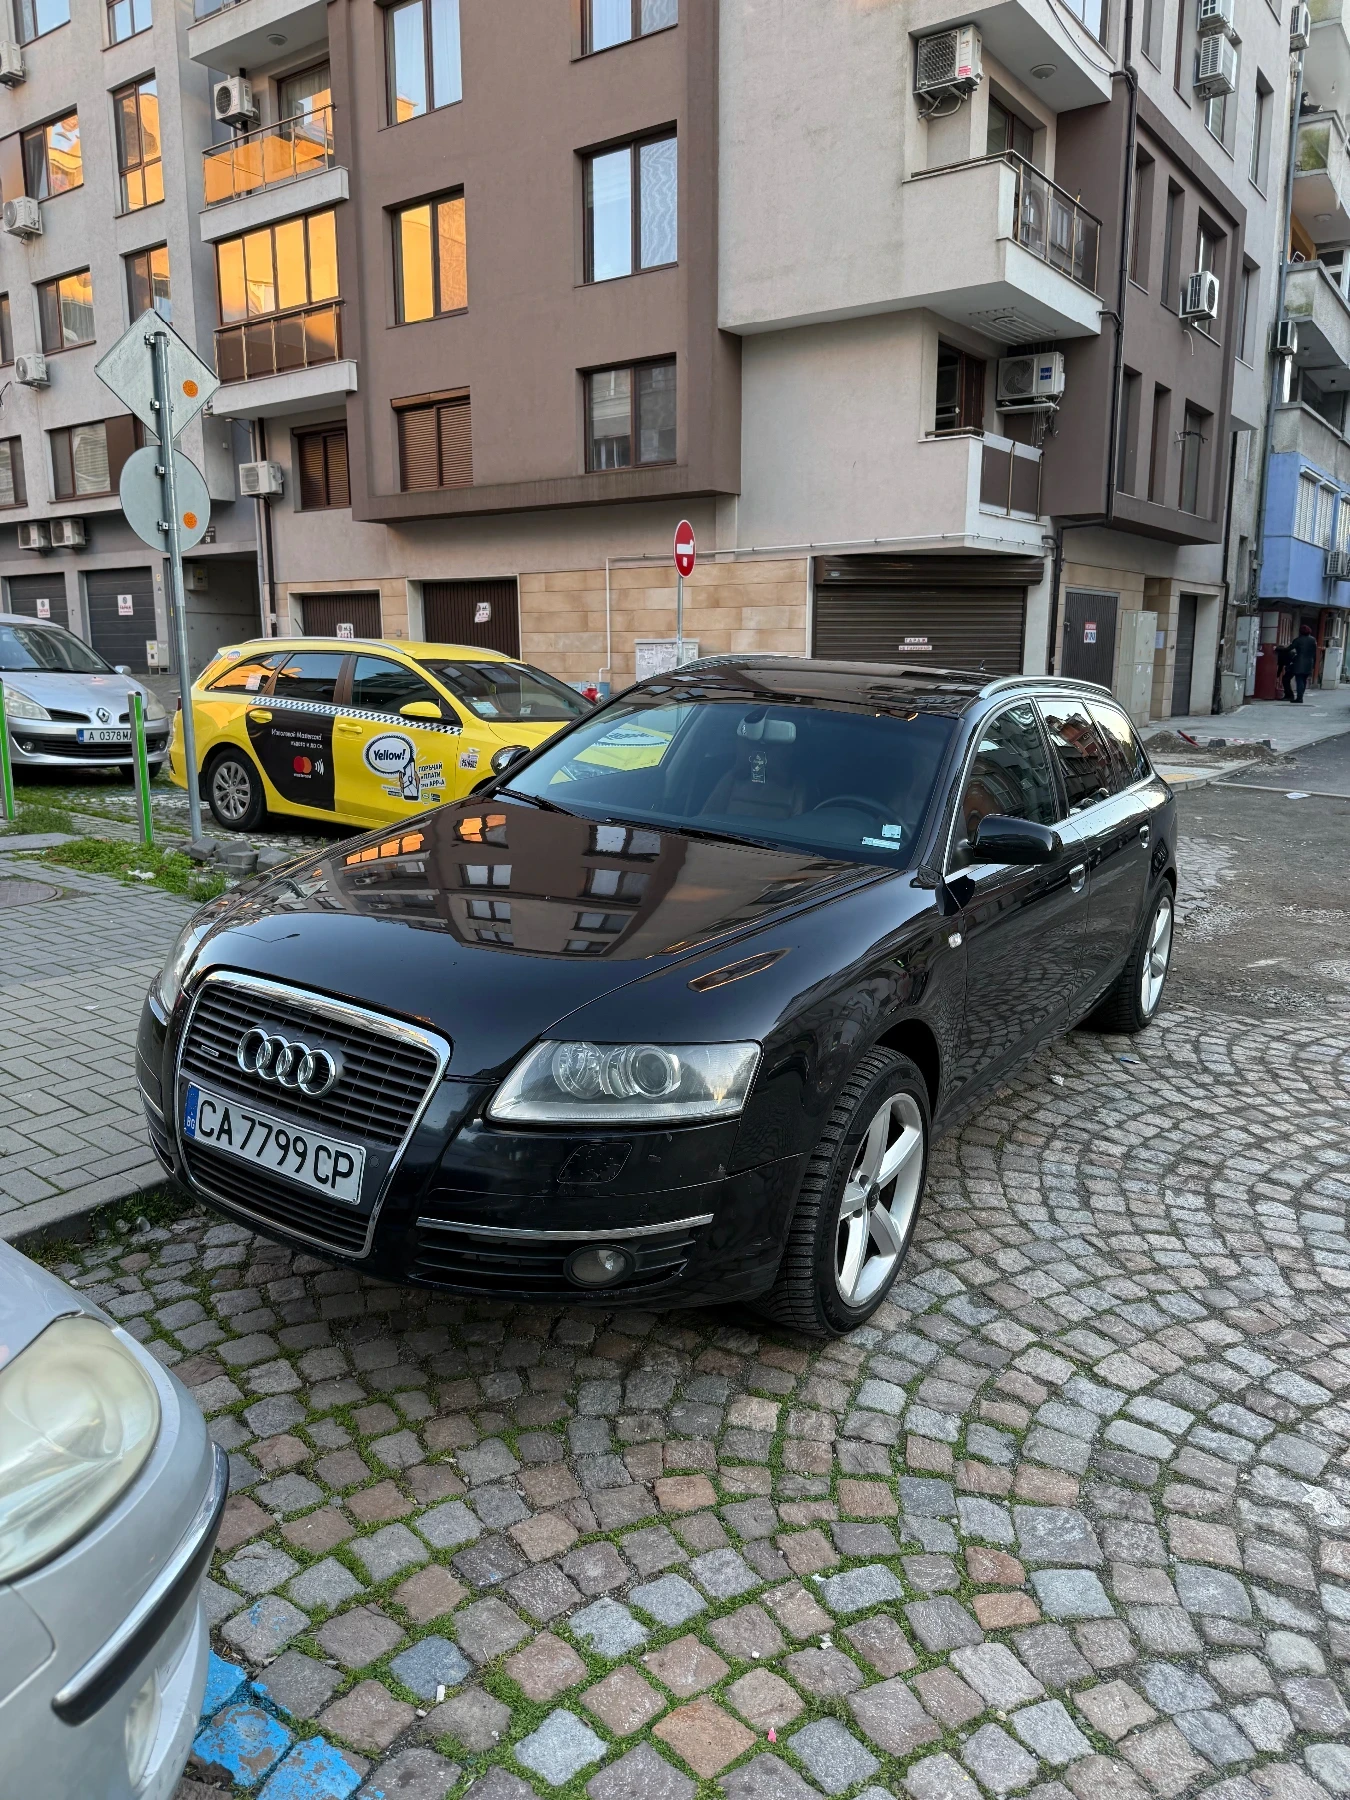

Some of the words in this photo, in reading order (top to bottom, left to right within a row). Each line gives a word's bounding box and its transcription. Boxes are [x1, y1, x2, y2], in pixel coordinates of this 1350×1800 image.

[88, 731, 94, 740] A
[100, 731, 122, 740] 0378
[122, 731, 132, 740] M
[374, 748, 406, 760] Yellow!
[186, 1115, 196, 1130] BG
